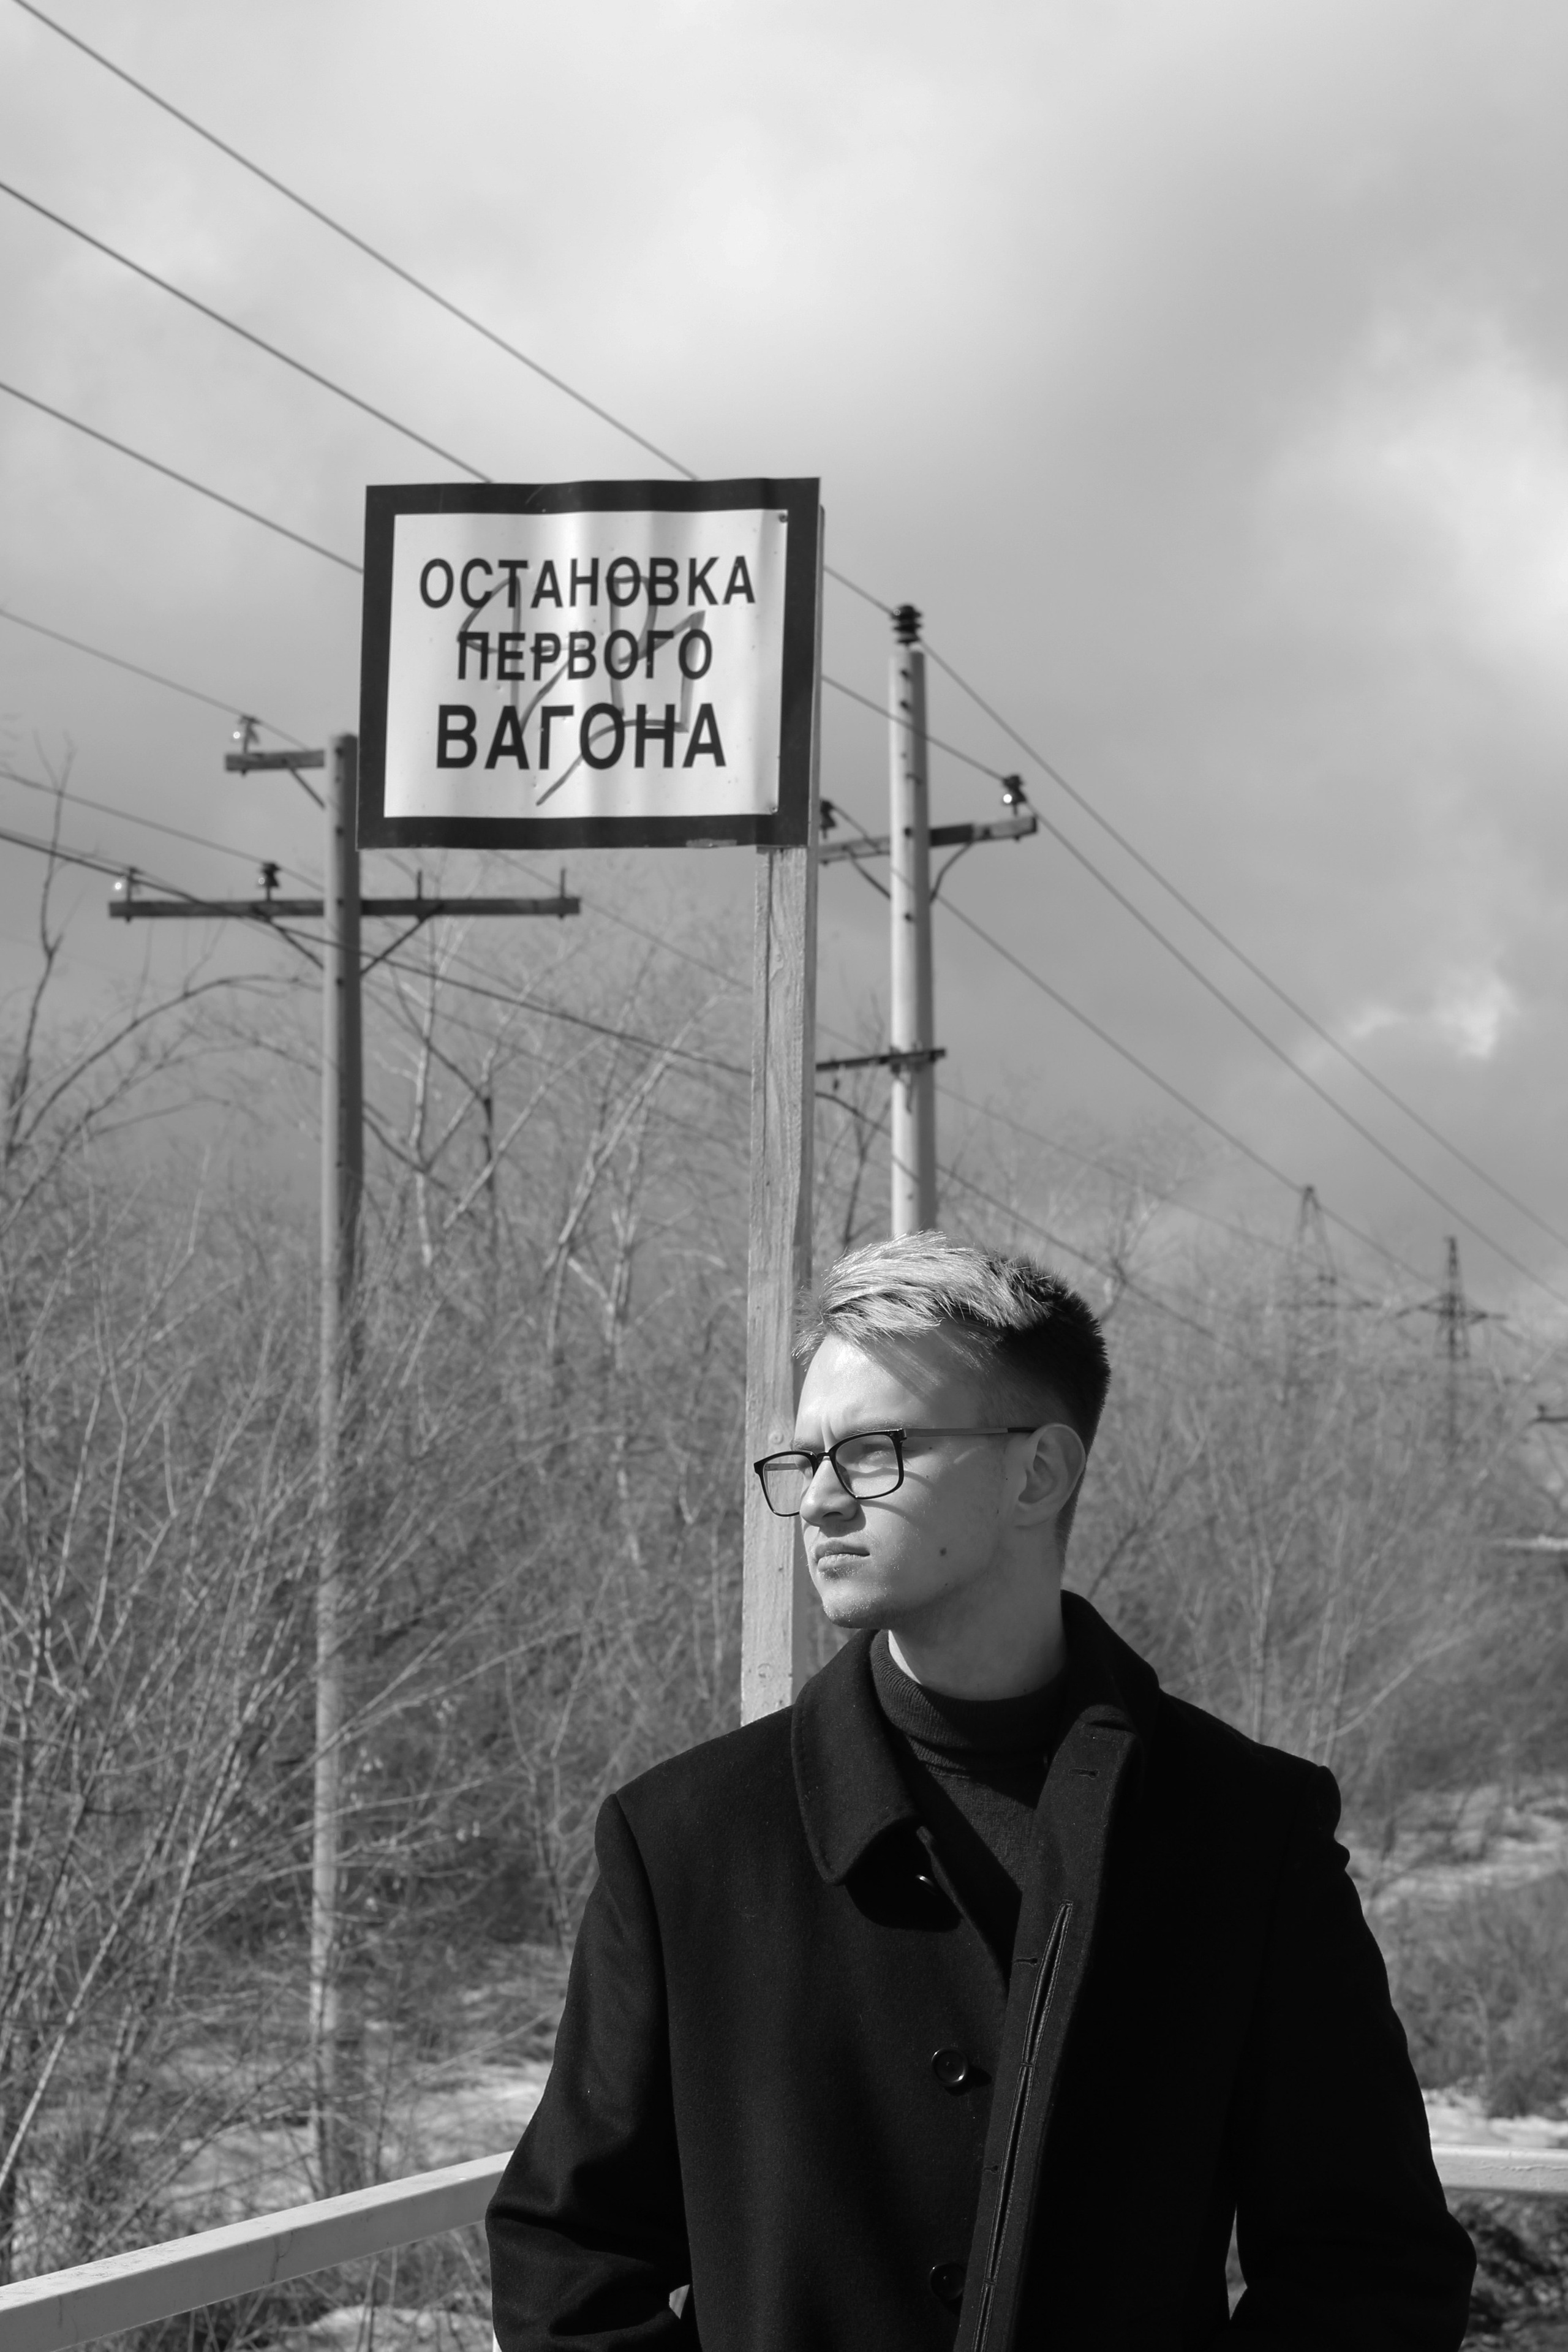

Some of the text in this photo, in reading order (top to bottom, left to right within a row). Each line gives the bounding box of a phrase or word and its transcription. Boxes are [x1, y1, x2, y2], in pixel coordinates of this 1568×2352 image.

[420, 556, 755, 609] ОСТАНОВКА
[457, 628, 712, 681] ПЕРВОГО
[436, 703, 726, 770] ВАГОНА
